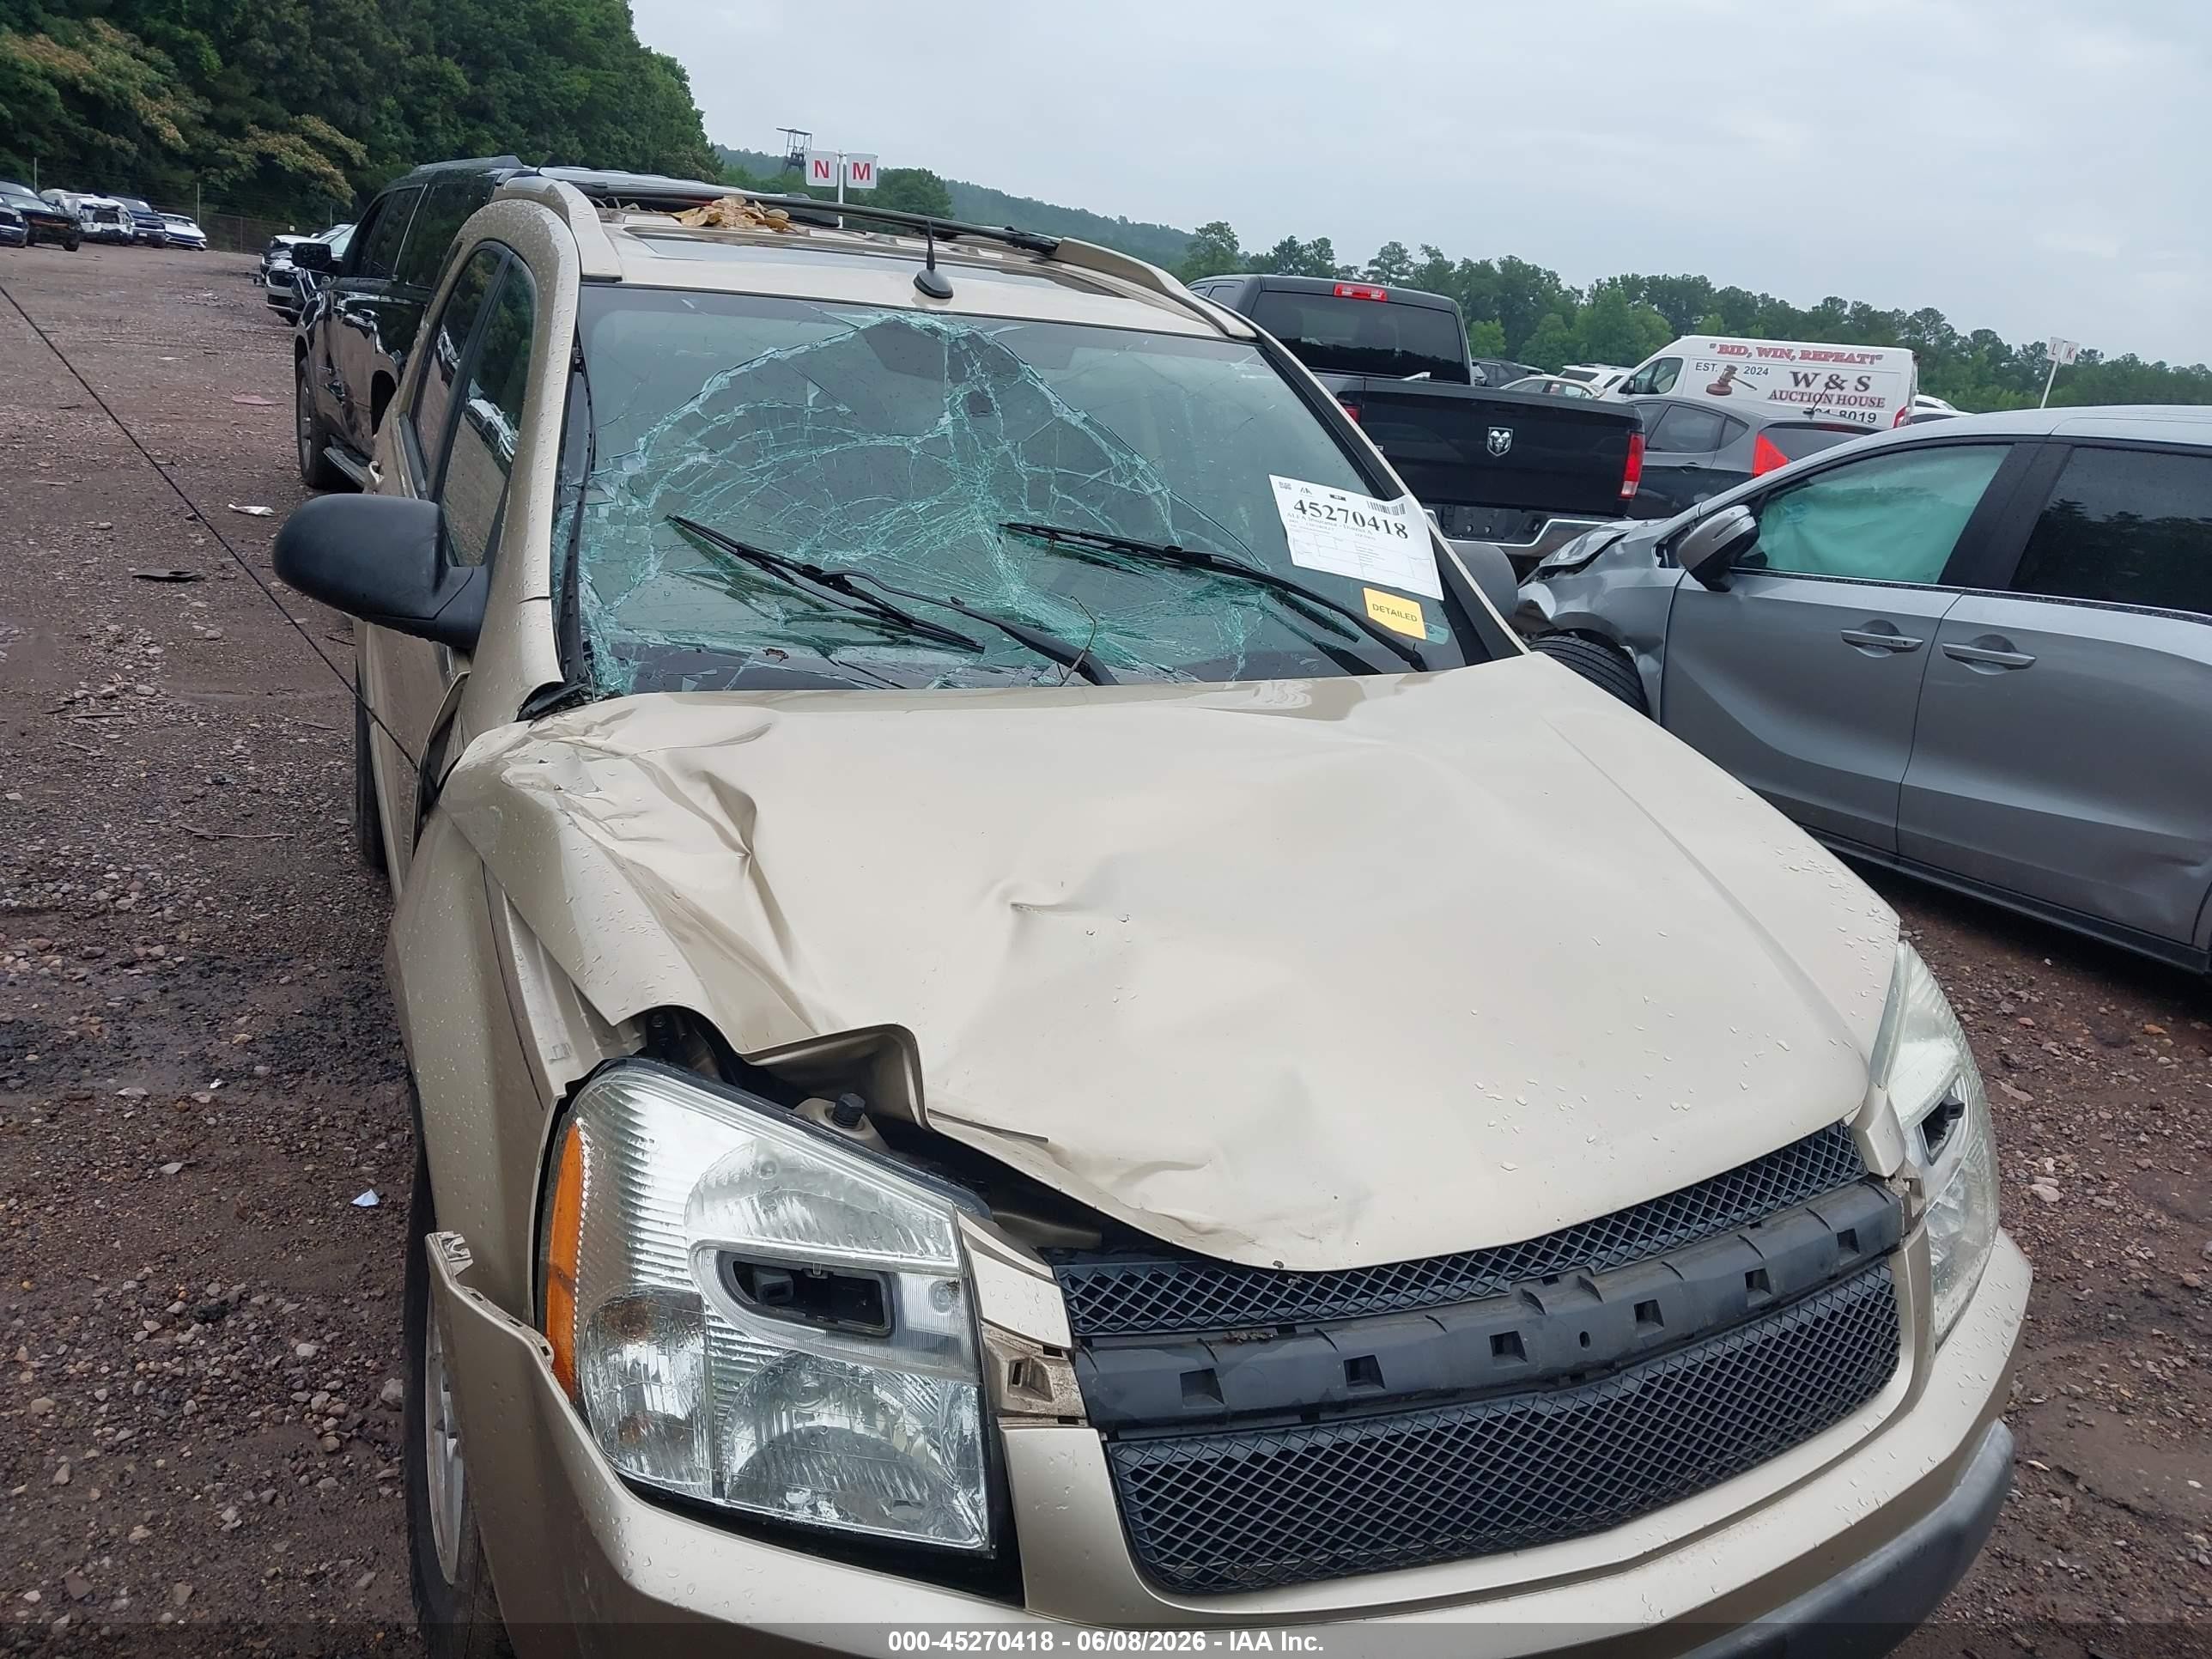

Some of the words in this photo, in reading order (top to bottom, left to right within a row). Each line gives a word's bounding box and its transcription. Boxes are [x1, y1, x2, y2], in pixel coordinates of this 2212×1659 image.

[814, 160, 830, 179] N
[853, 162, 871, 180] M
[1756, 347, 1796, 361] WIN,
[2067, 347, 2075, 359] K
[1695, 362, 1717, 373] EST.
[1743, 366, 1769, 375] 2024
[1790, 371, 1821, 388] W
[1825, 374, 1848, 391] &
[1855, 375, 1872, 392] S
[1767, 390, 1836, 404] AUCTION
[1836, 394, 1886, 408] HOUSE
[1293, 499, 1408, 539] 45270418
[1372, 604, 1418, 623] DETAILED
